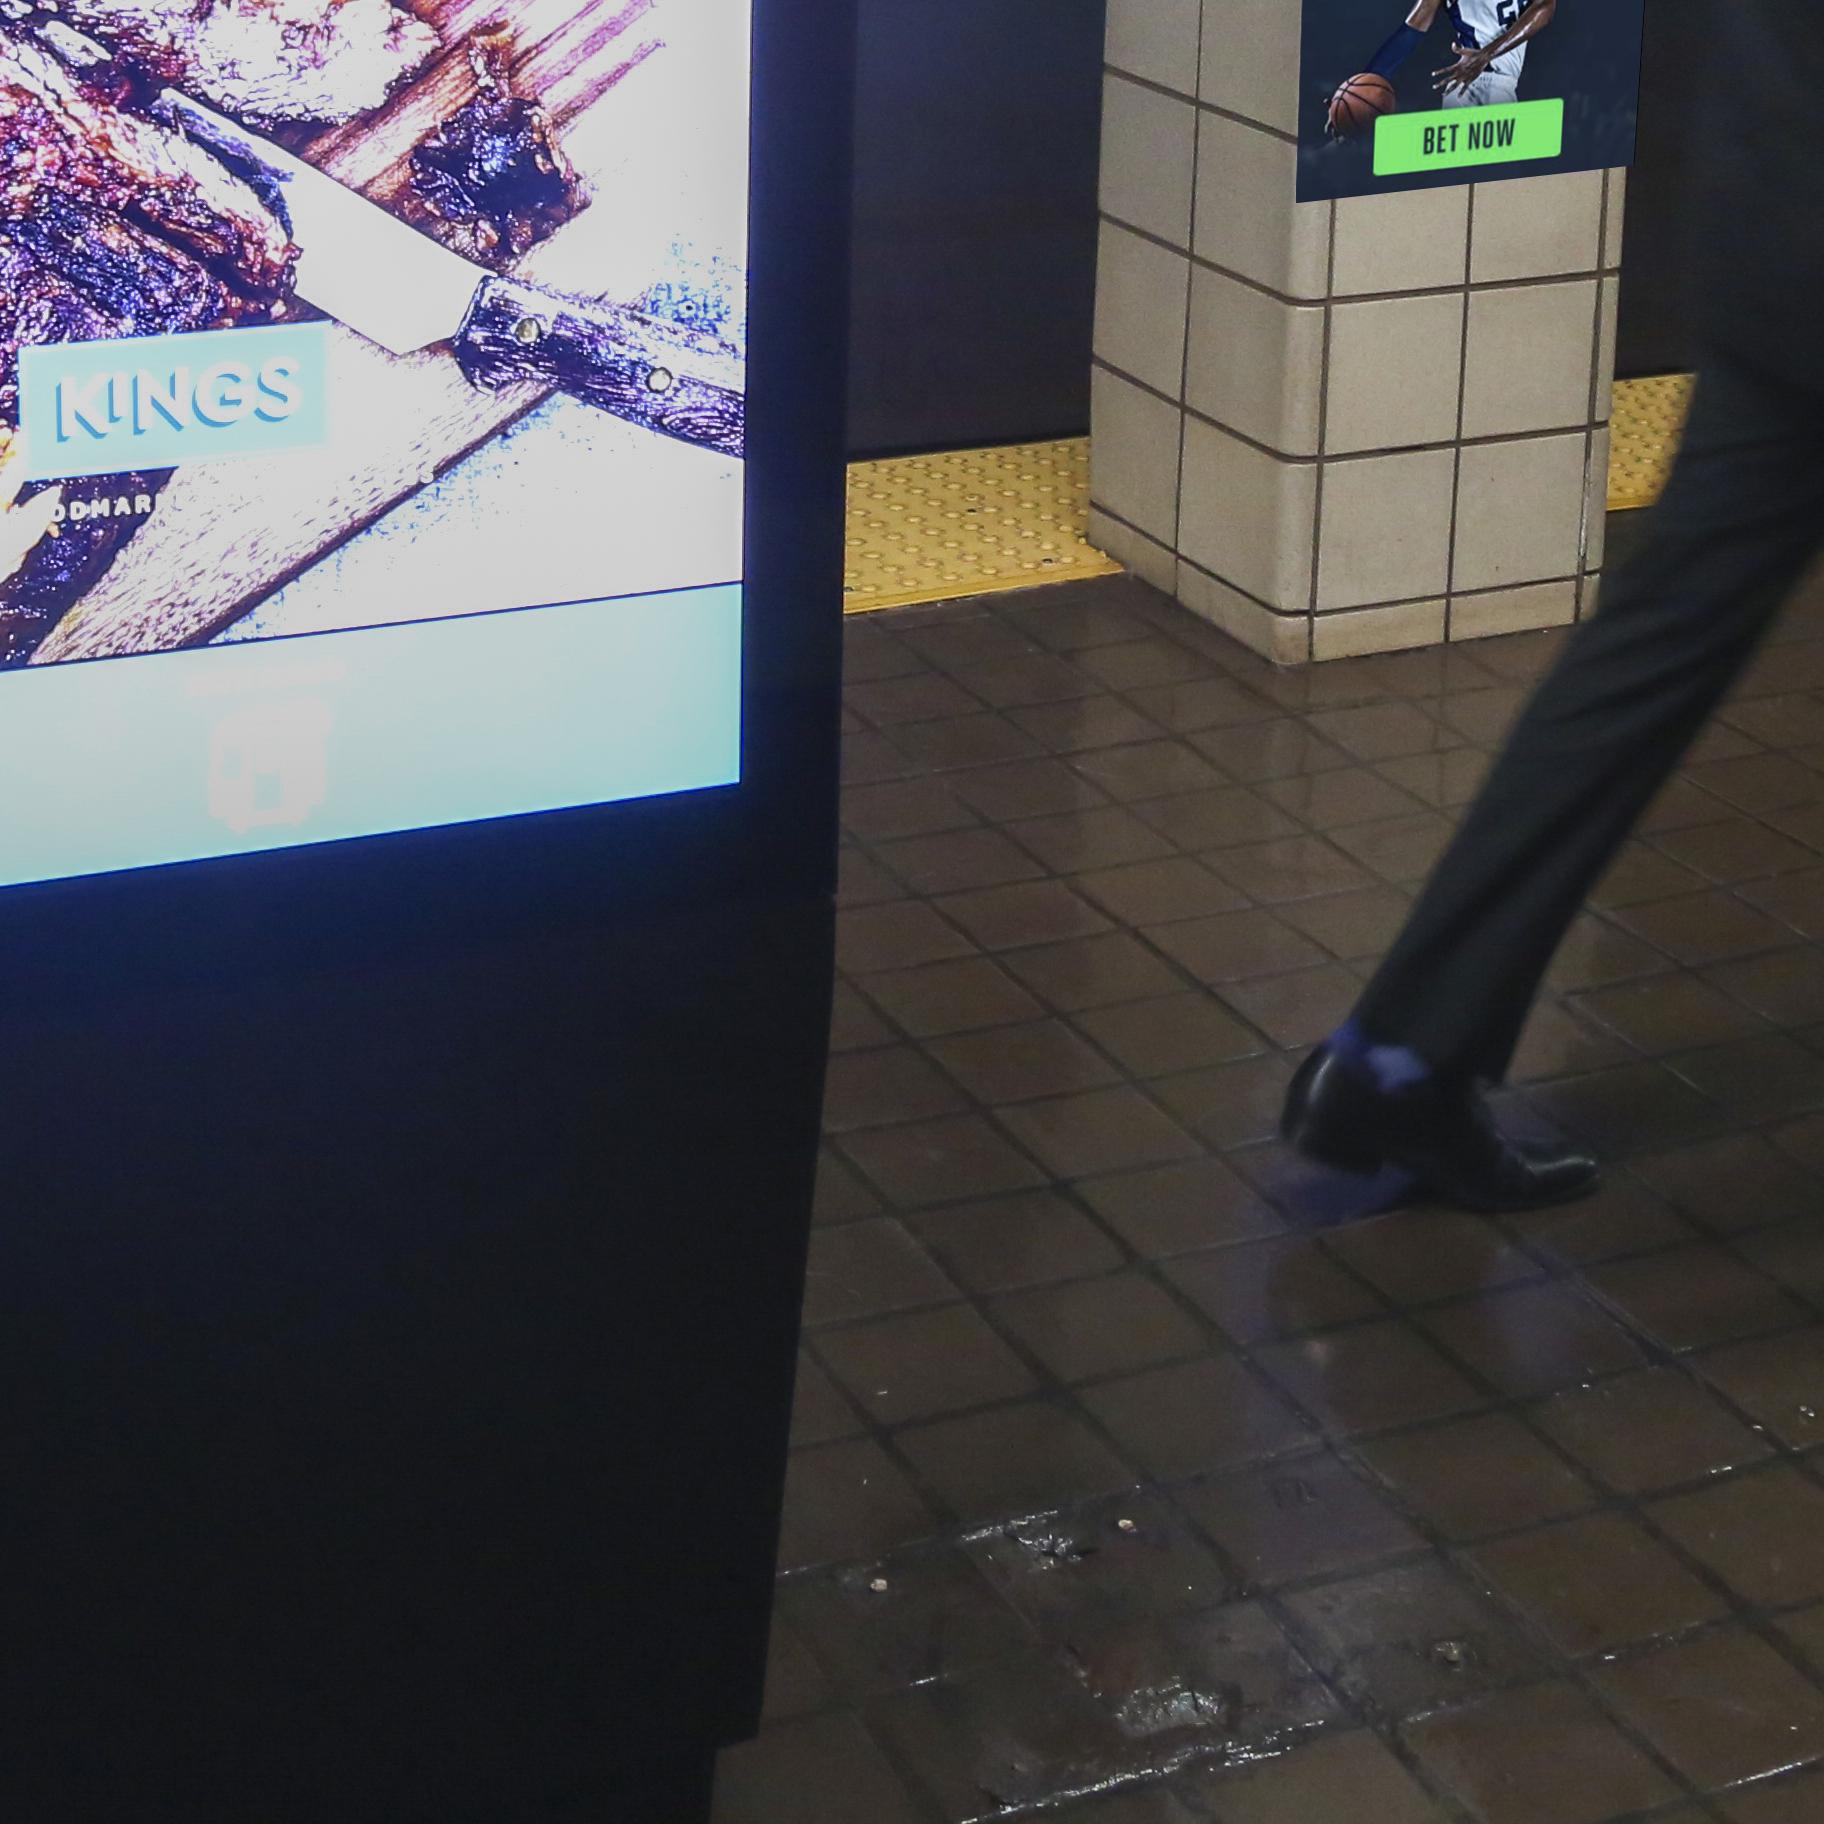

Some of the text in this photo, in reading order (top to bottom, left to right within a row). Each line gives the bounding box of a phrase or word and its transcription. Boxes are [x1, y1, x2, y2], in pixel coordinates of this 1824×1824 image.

[1422, 118, 1516, 155] BET NOW
[55, 355, 302, 443] KINGS
